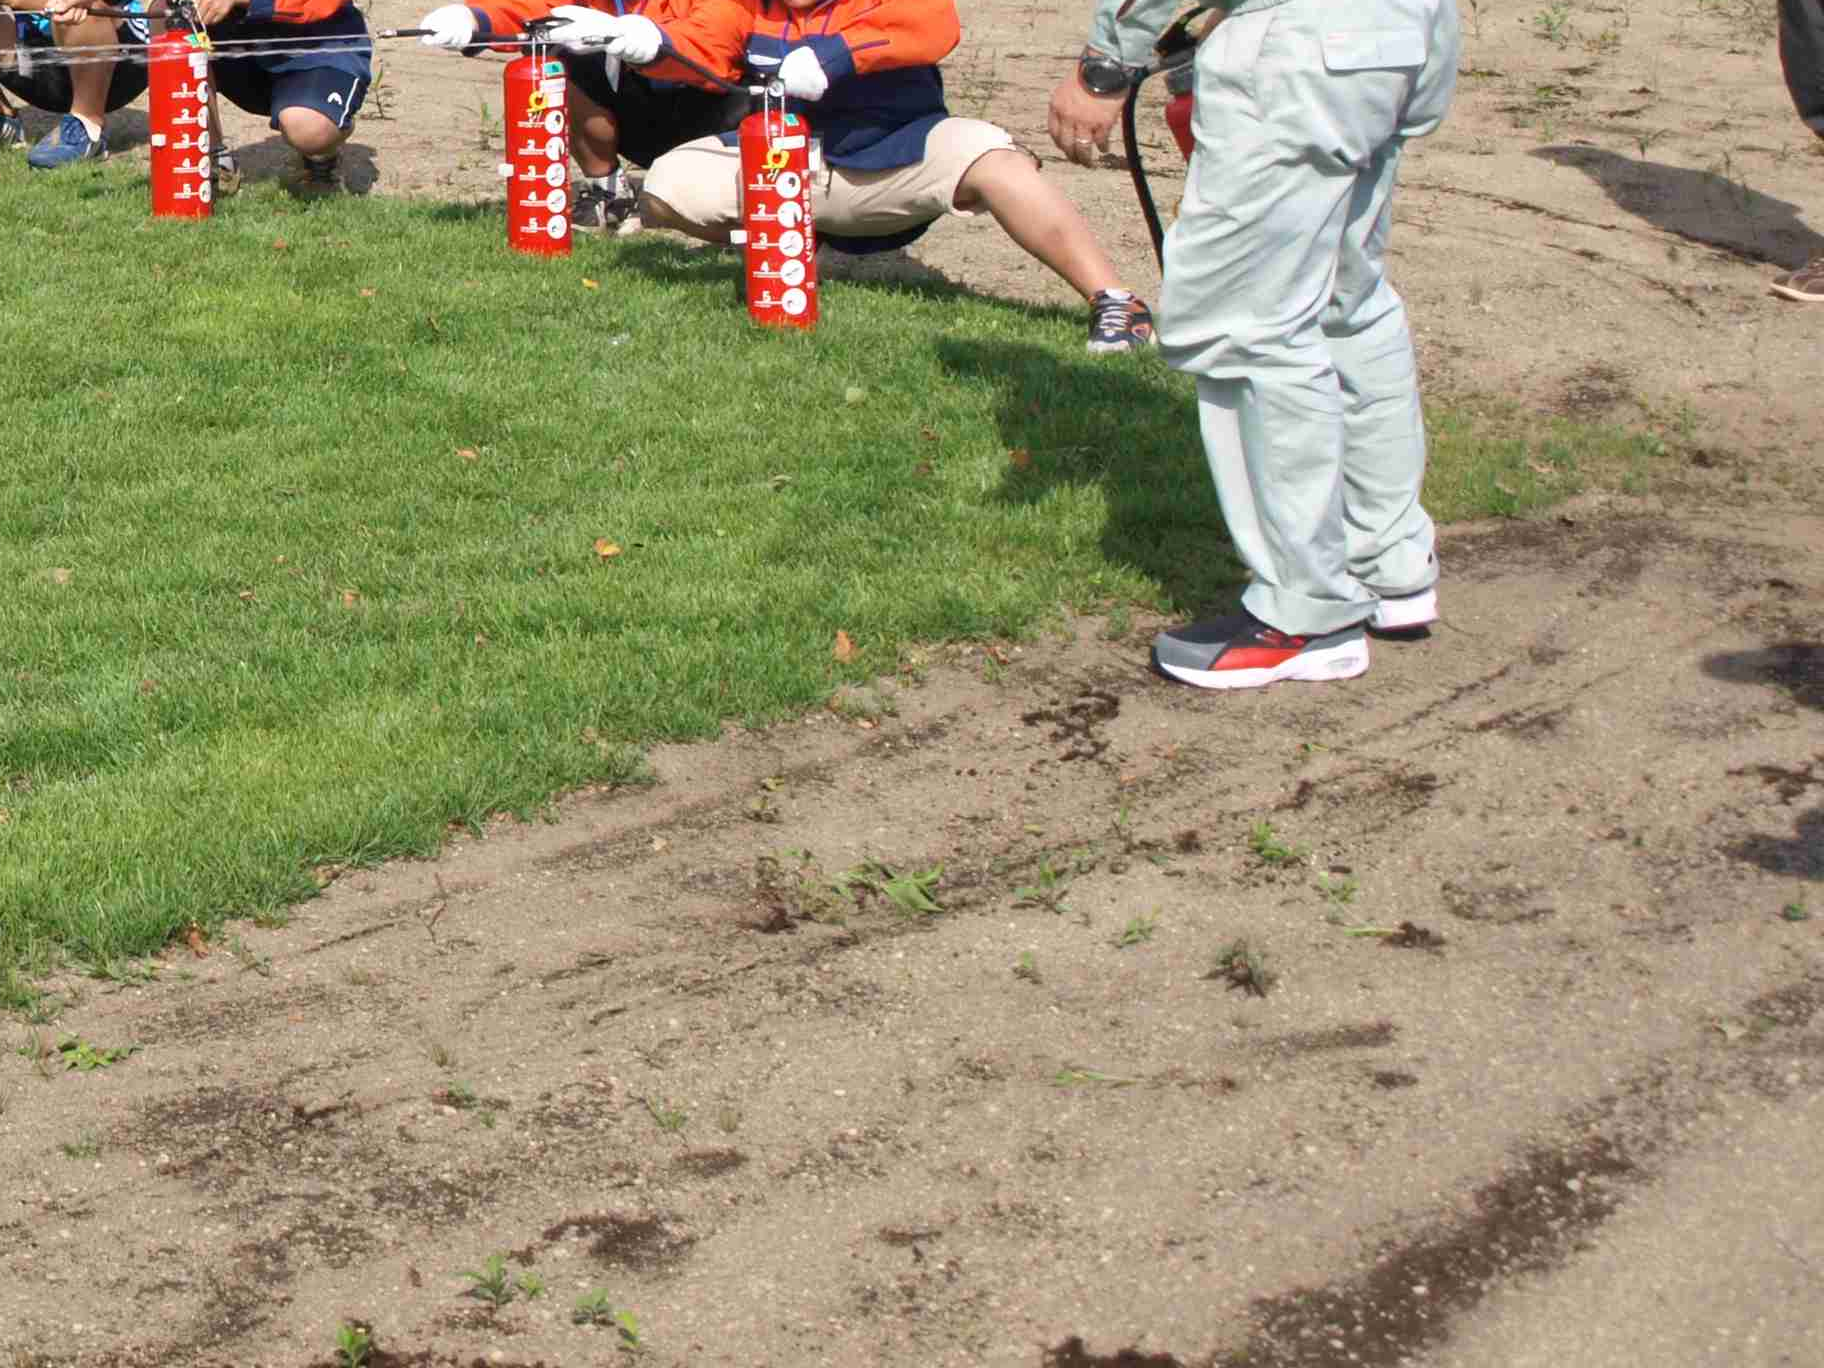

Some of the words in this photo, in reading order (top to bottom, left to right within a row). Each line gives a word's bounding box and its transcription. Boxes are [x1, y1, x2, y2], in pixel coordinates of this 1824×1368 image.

[181, 108, 190, 119] 2
[527, 139, 536, 150] 2
[528, 165, 536, 176] 3
[756, 173, 764, 185] 1
[528, 190, 537, 202] 4
[758, 203, 767, 215] 2
[529, 217, 538, 228] 5
[759, 232, 768, 245] 3
[760, 260, 770, 273] 4
[762, 290, 772, 302] 5
